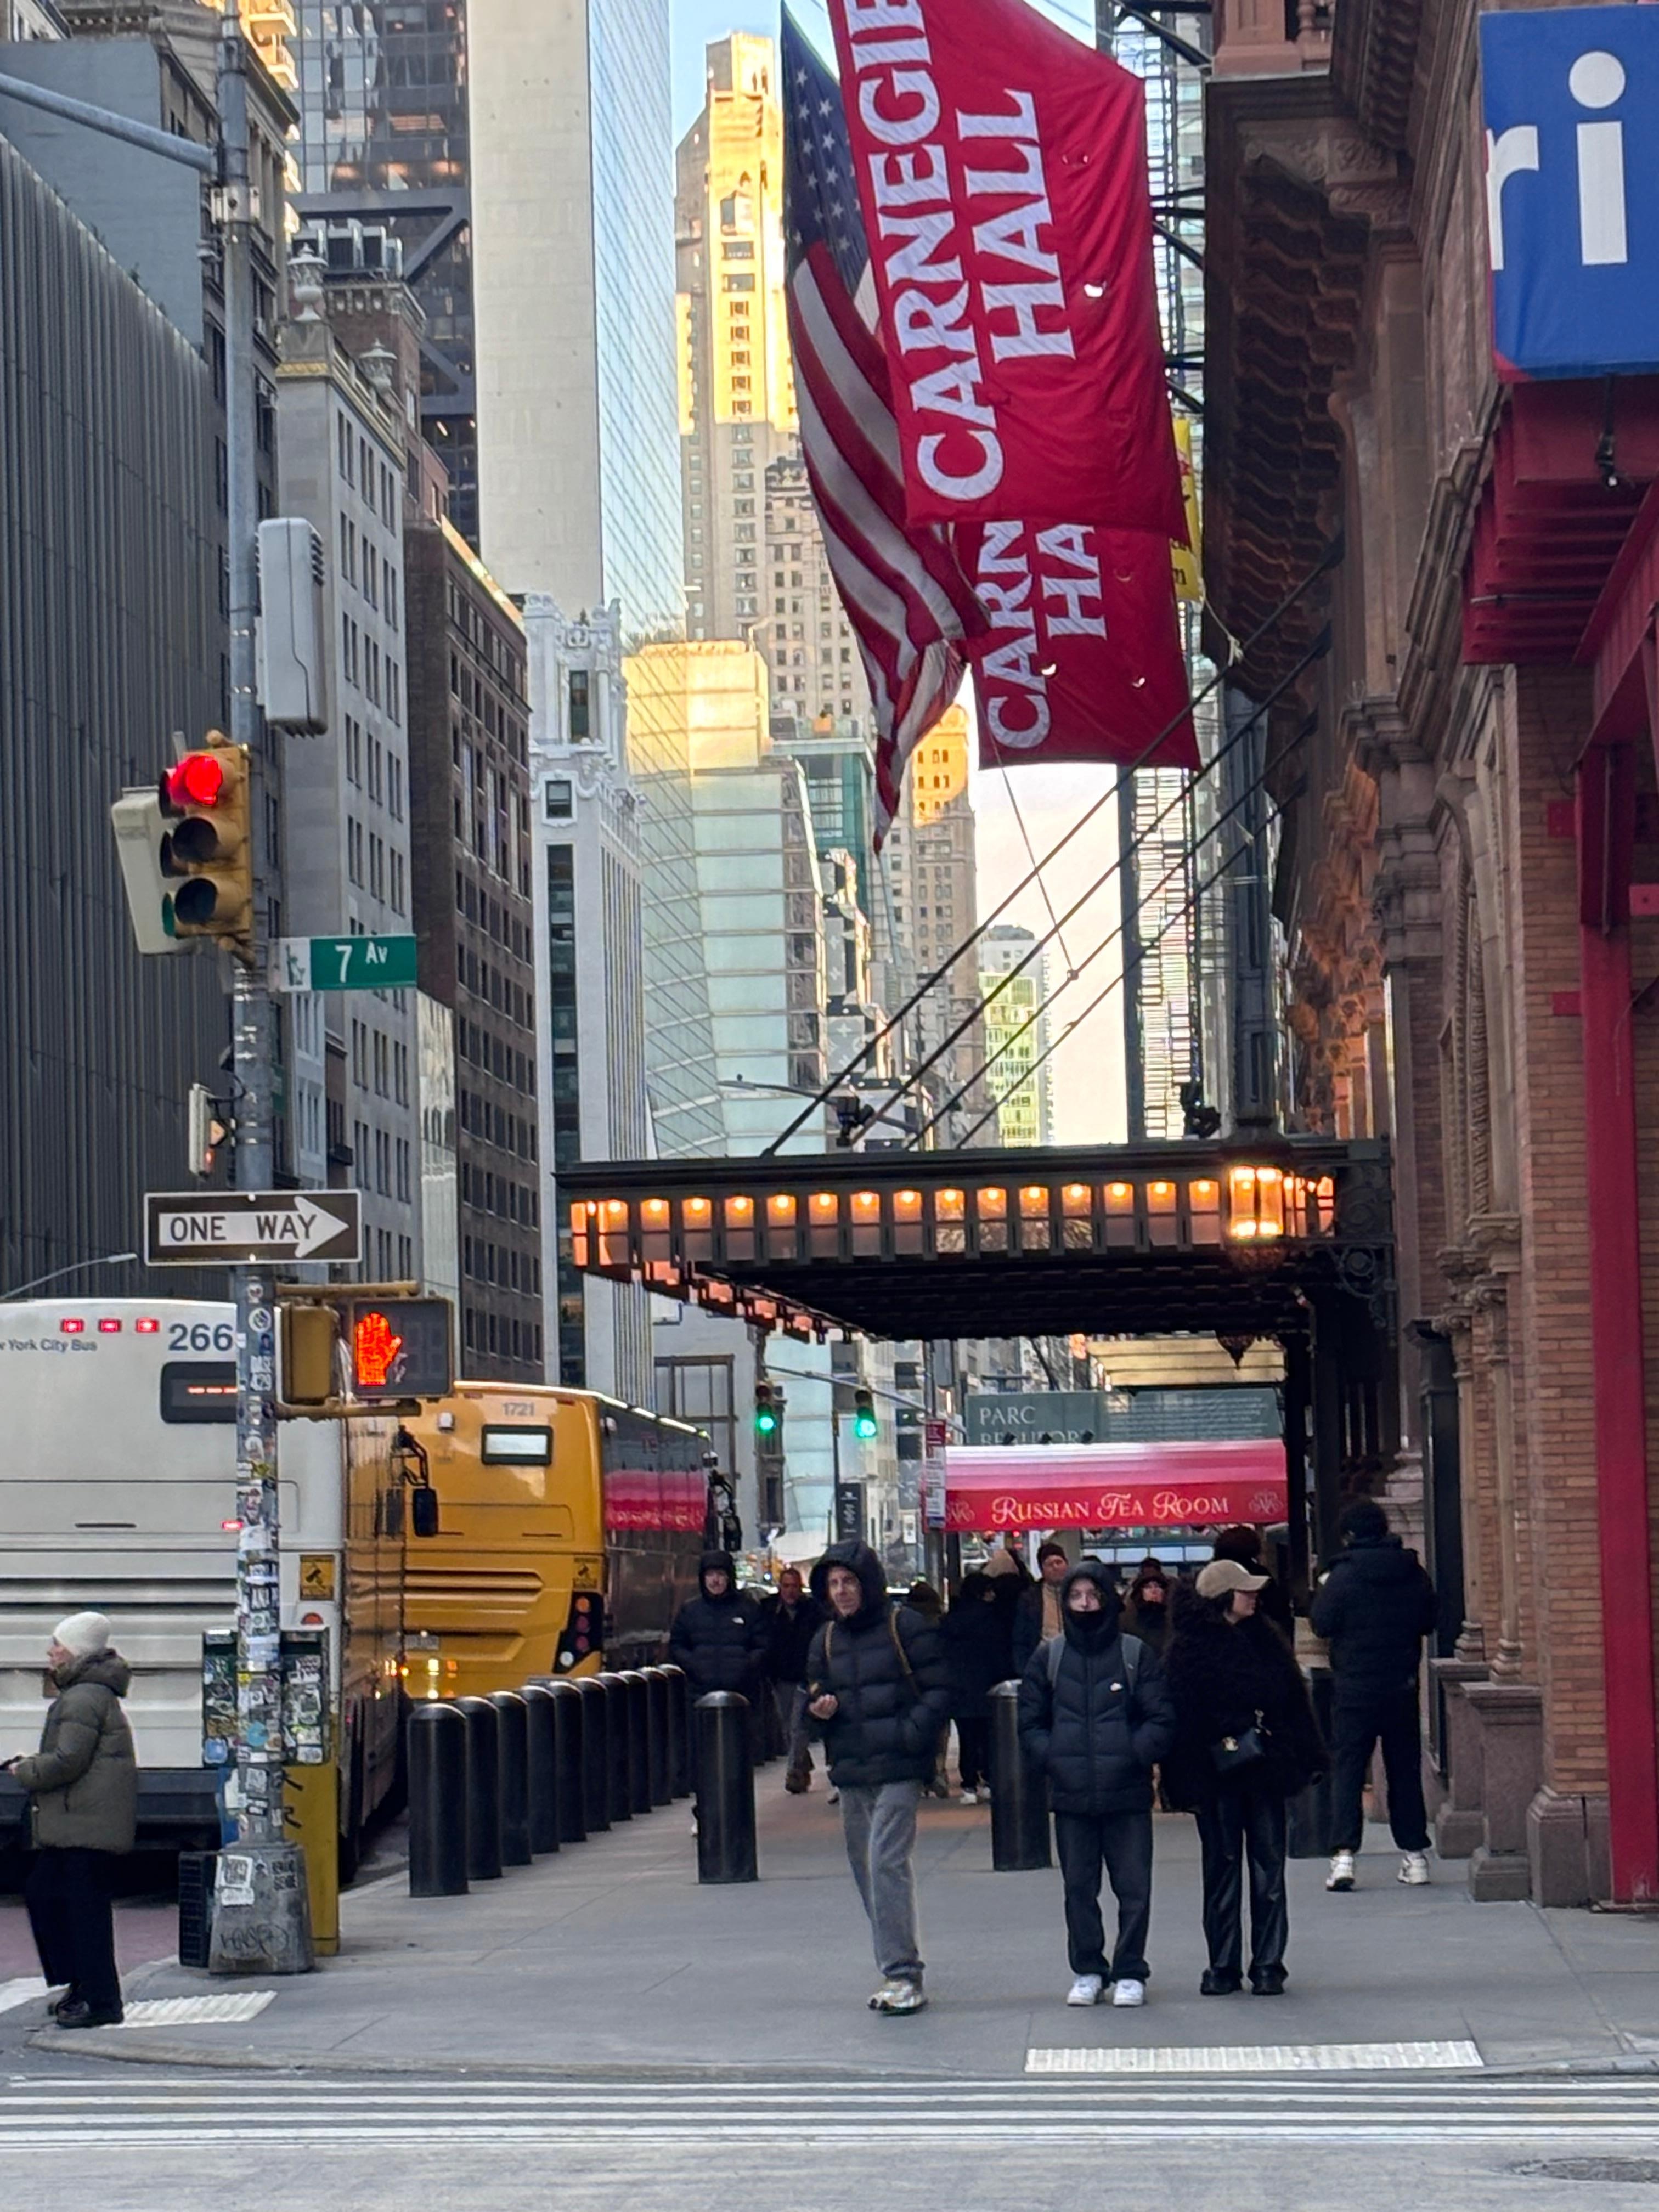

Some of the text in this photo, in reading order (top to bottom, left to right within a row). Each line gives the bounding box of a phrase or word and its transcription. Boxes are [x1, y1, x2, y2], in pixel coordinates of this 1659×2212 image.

[956, 89, 1076, 363] HALL
[847, 0, 1003, 500] CARNEGIE
[1036, 523, 1108, 641] HA
[974, 520, 1051, 749] CARN
[334, 945, 352, 983] 7
[170, 1214, 318, 1242] ONE WAY
[8, 1339, 39, 1351] York
[40, 1338, 69, 1354] City
[71, 1339, 98, 1351] Bus
[501, 1401, 534, 1417] 1721
[979, 1406, 1036, 1425] PARC
